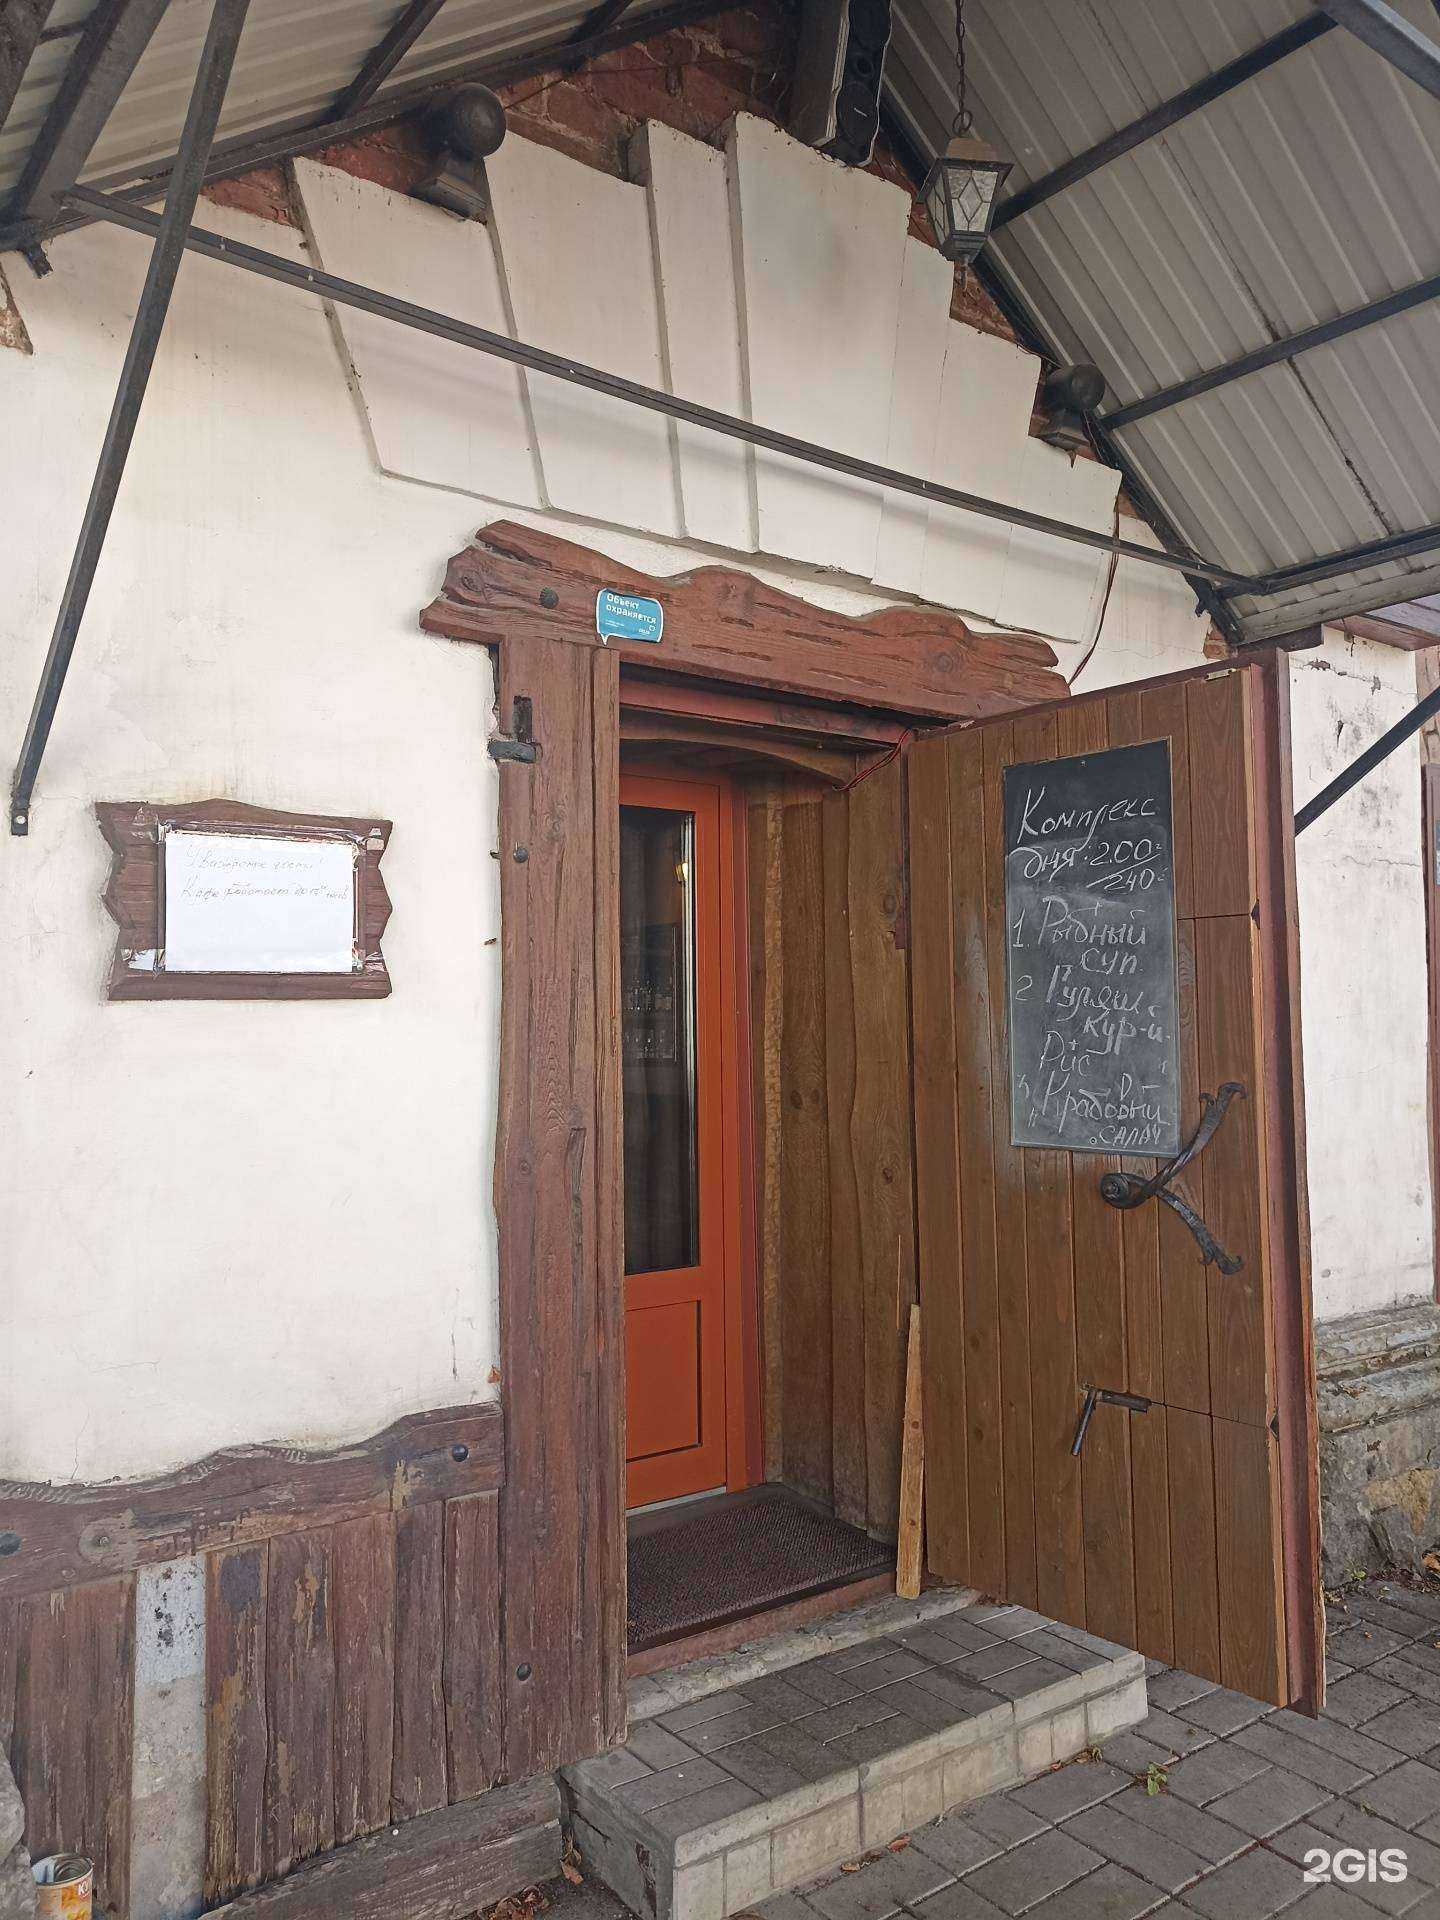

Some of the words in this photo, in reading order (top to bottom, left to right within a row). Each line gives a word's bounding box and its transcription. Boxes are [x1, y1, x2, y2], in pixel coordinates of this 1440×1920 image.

[606, 593, 640, 609] Объект
[606, 604, 657, 624] охраняется
[1016, 786, 1157, 850] Комплекс
[1037, 895, 1147, 946] Рыбный
